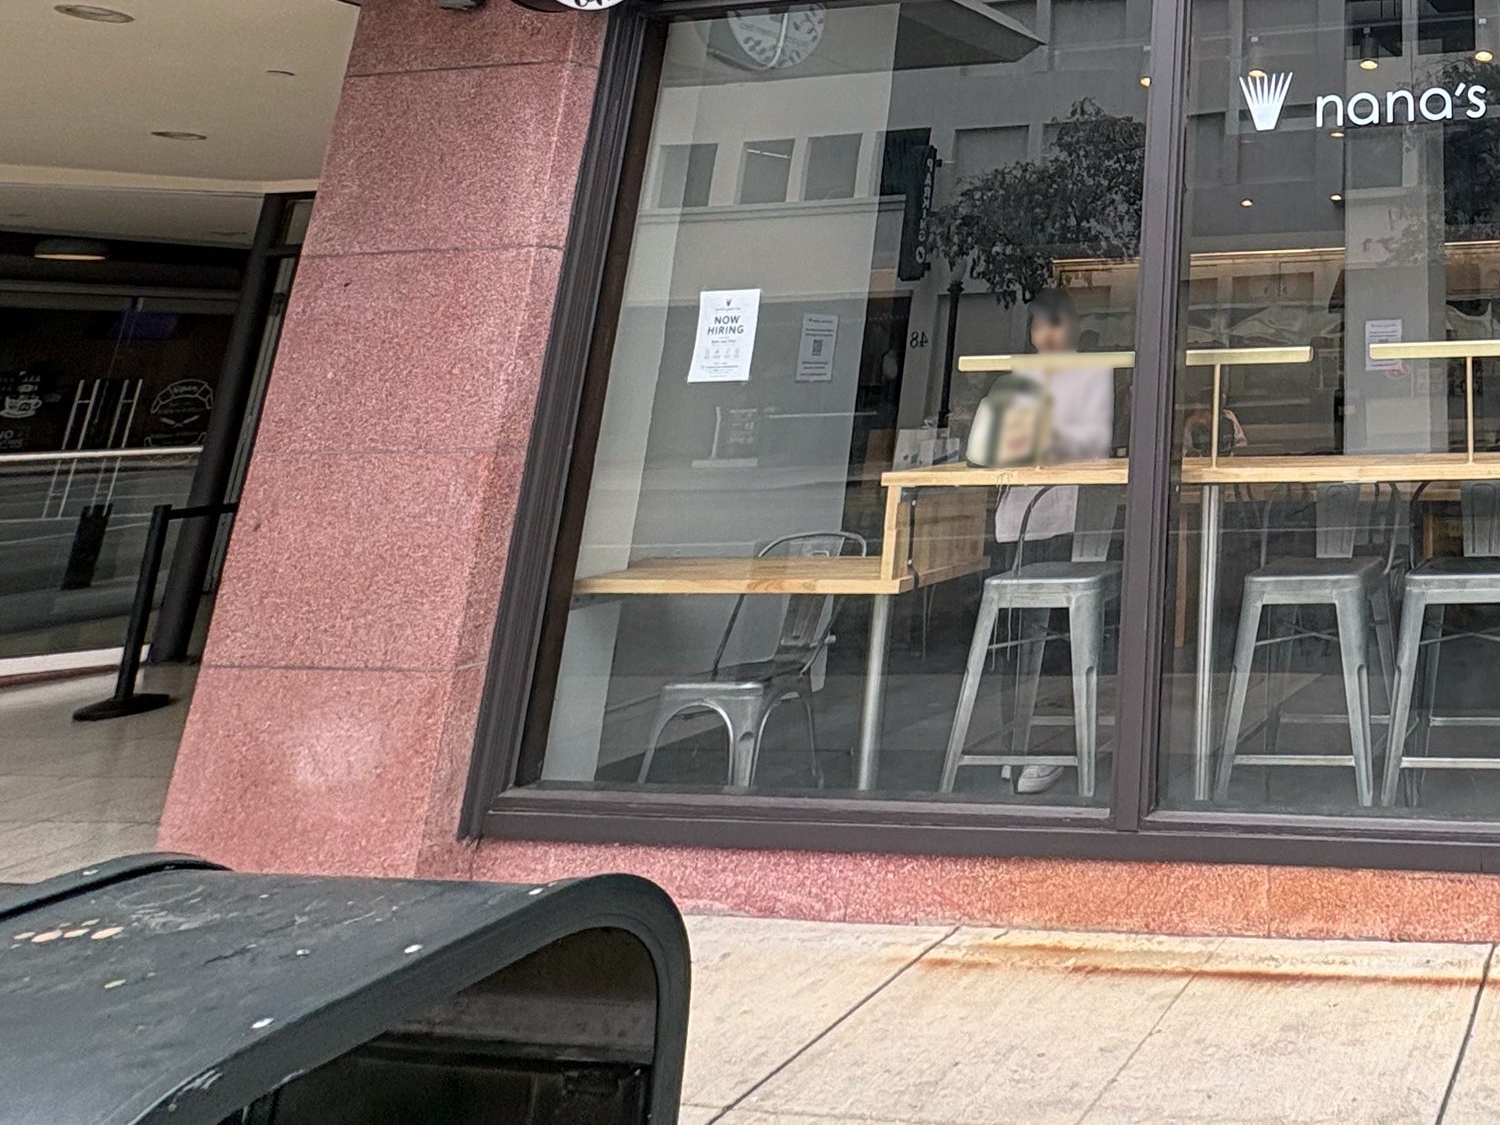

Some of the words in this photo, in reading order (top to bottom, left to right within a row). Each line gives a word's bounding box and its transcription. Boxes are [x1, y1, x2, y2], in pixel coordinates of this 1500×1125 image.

[1315, 81, 1488, 128] nana's
[714, 314, 741, 326] NOW
[707, 324, 745, 337] HIRING
